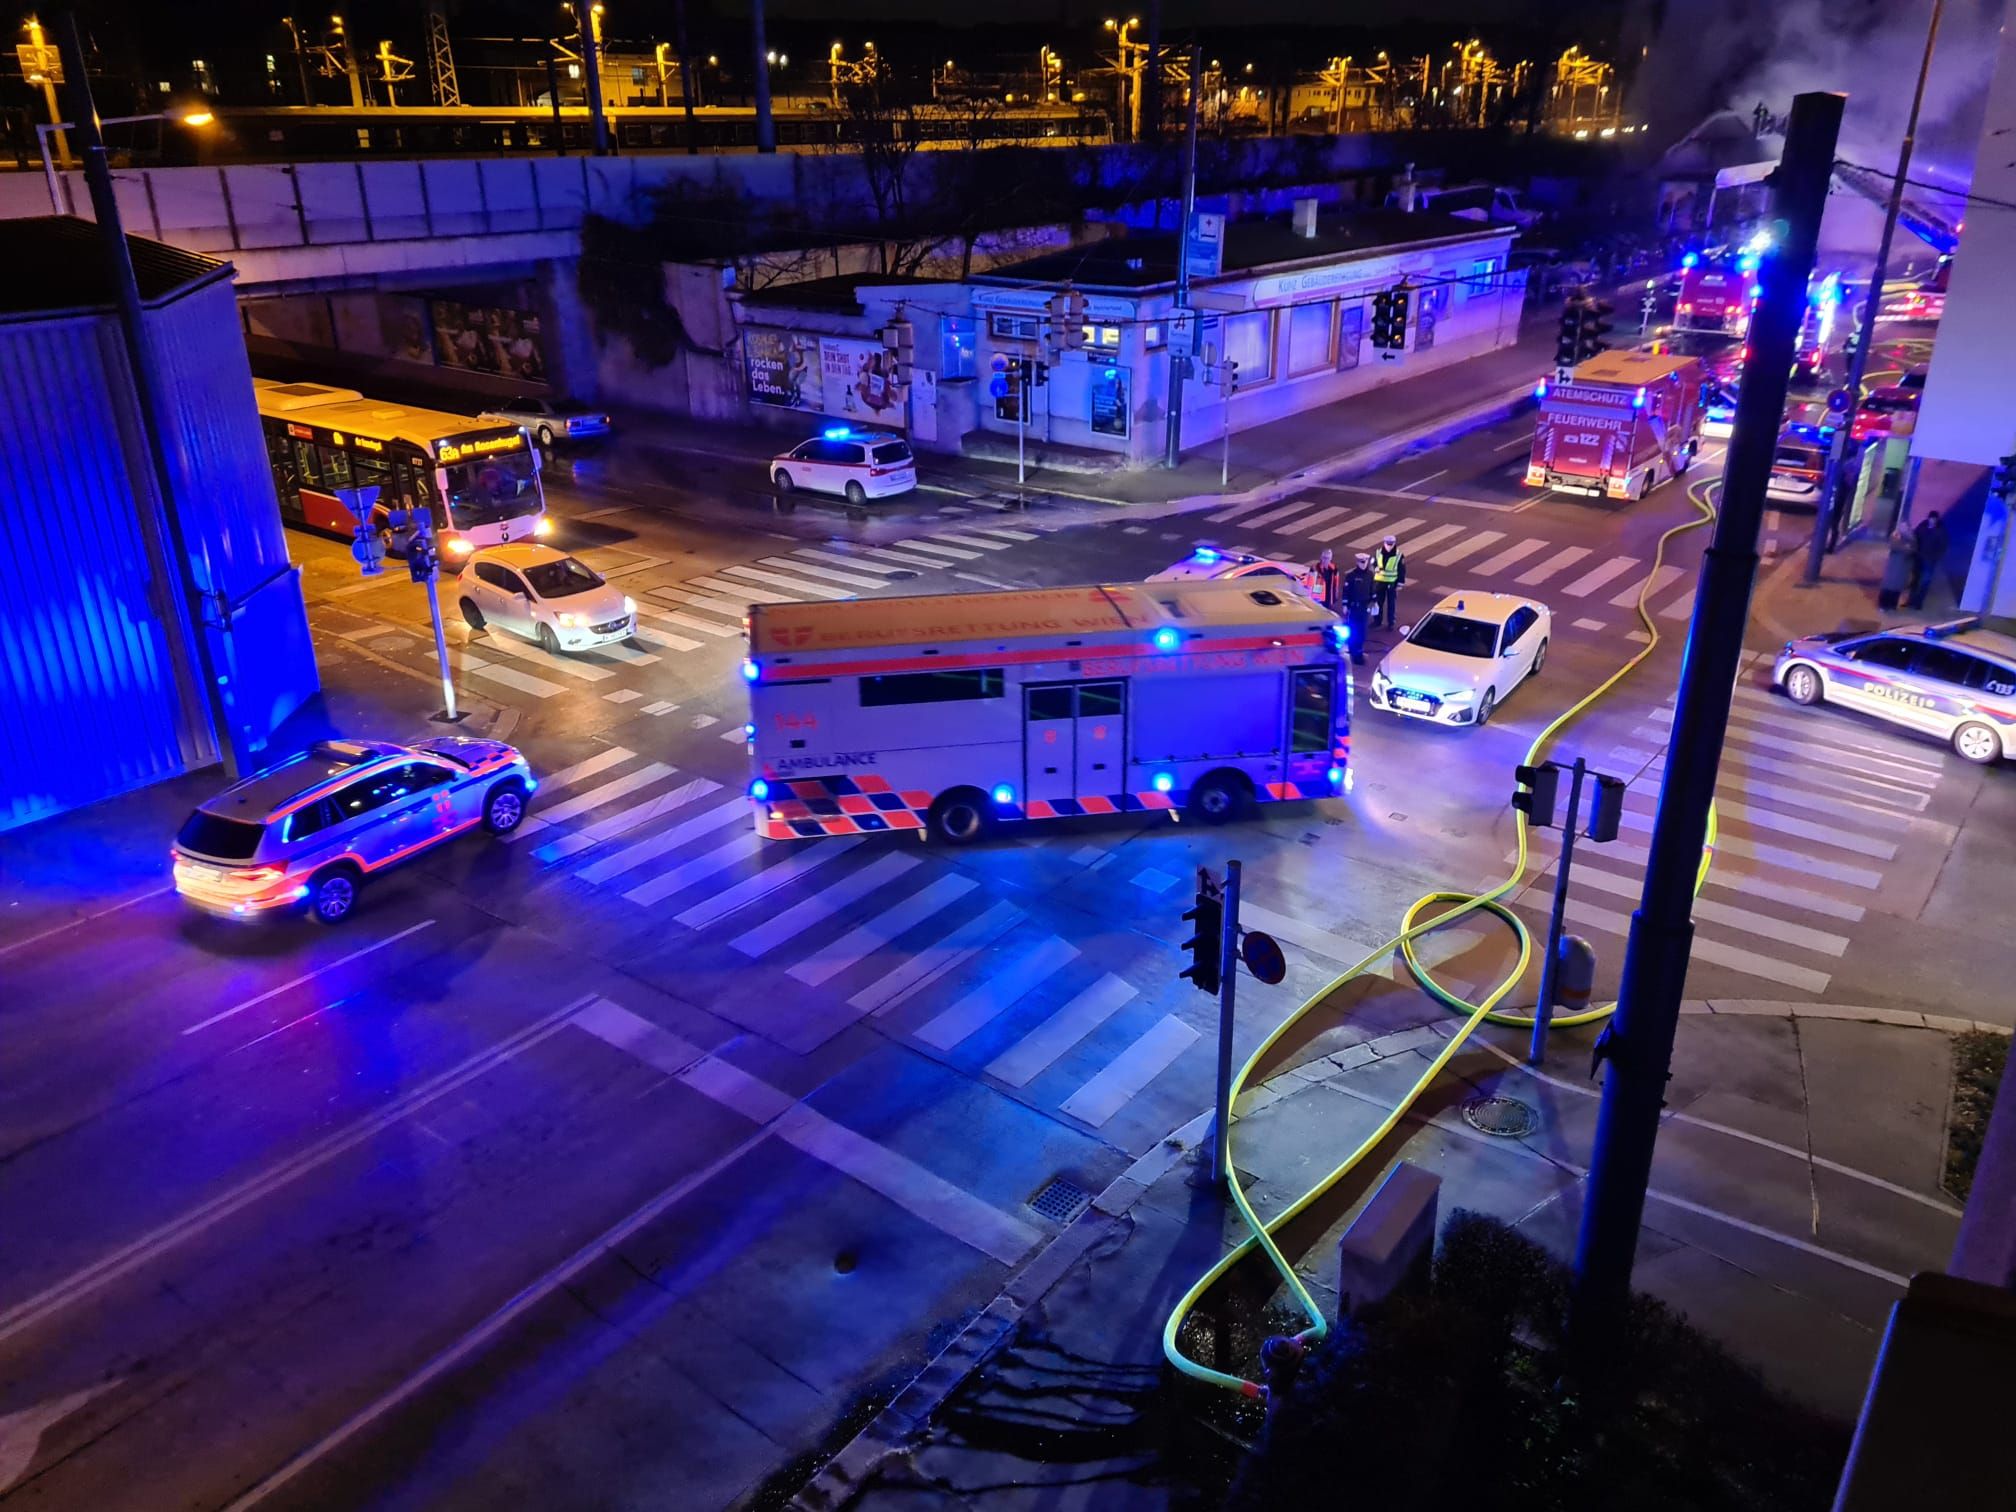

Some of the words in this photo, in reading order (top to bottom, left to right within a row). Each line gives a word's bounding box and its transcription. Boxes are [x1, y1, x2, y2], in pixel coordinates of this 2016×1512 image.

[750, 357, 783, 371] rocken
[752, 368, 769, 381] das
[752, 380, 785, 395] Leben.
[1552, 388, 1628, 405] ATEMSCHUTZ
[1547, 413, 1622, 430] FEUERWEHR
[1580, 433, 1600, 446] 122
[440, 446, 459, 461] 63A
[1073, 615, 1149, 628] WIEN
[1253, 649, 1304, 667] WIEN
[1864, 682, 1924, 707] POLIZEI
[1995, 683, 2014, 695] 133
[775, 712, 817, 731] 144
[778, 752, 876, 770] AMBULANCE
